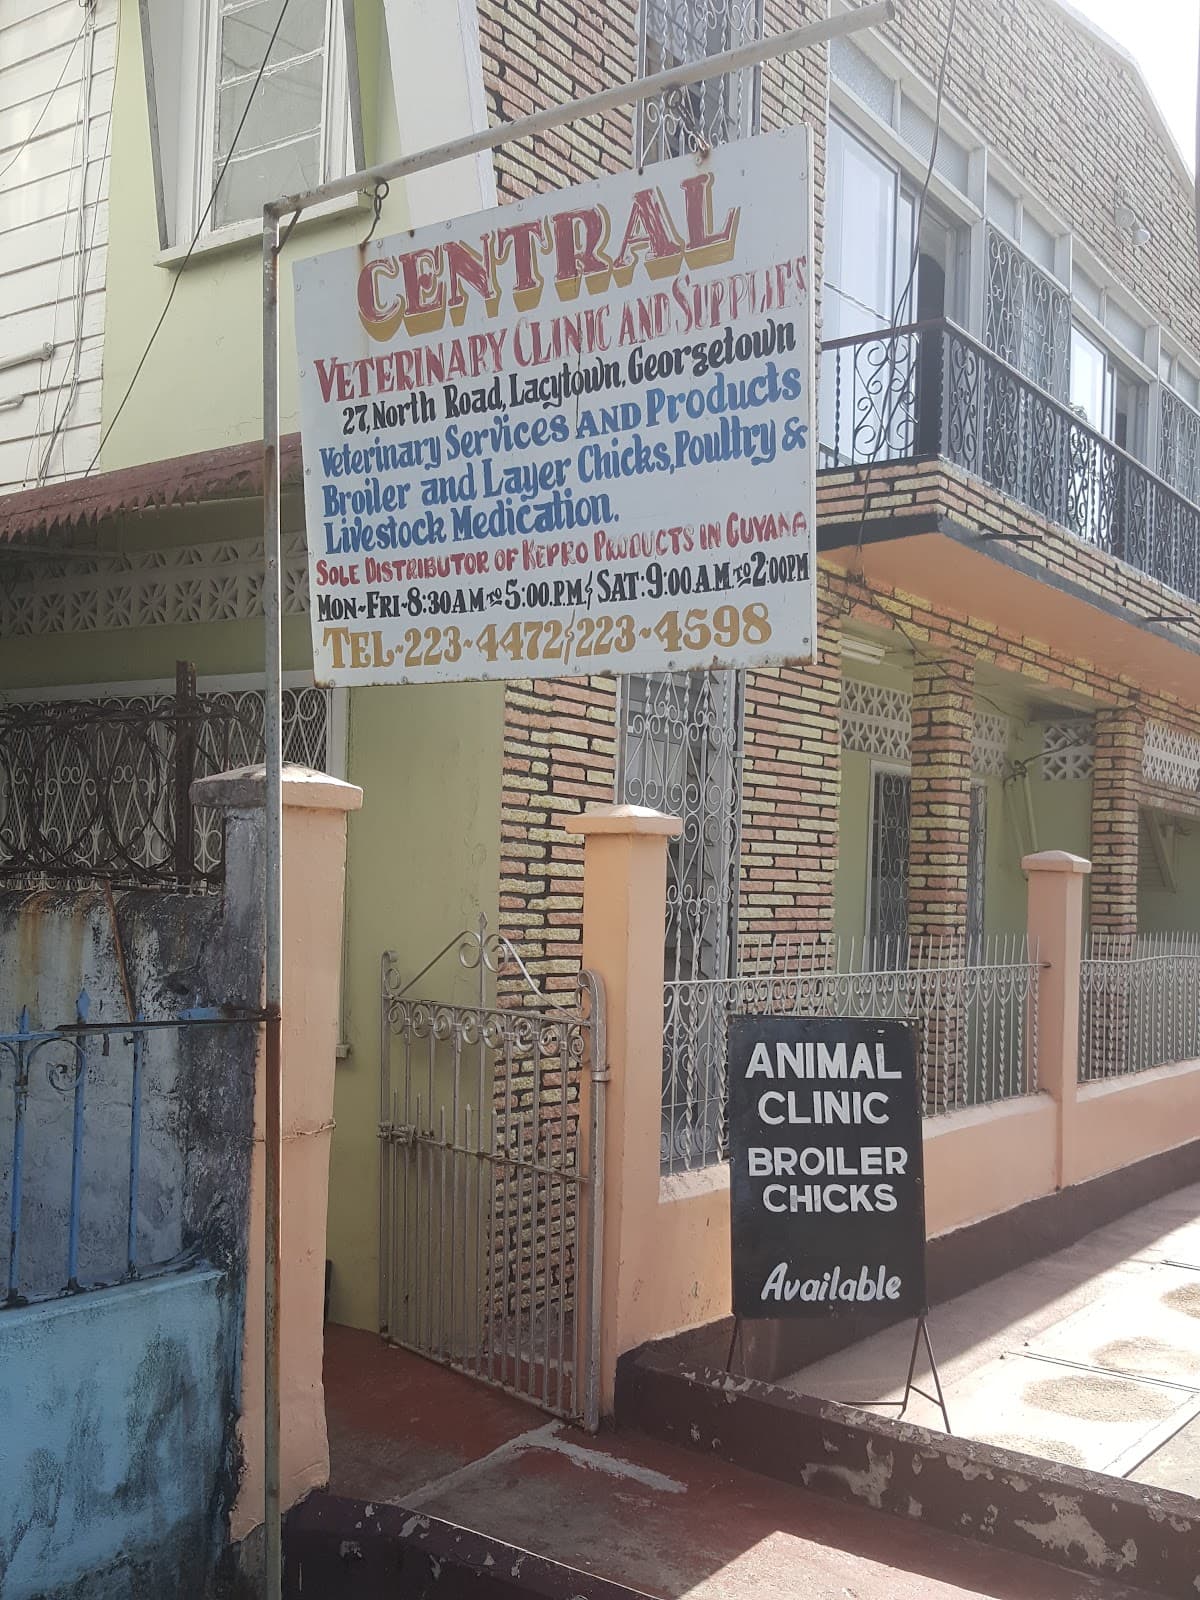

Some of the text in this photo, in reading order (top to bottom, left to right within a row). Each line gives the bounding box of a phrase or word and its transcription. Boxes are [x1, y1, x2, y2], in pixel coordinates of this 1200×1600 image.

[357, 172, 741, 342] CENTRAL
[313, 328, 508, 403] VETERINARY
[513, 304, 612, 367] CLINIC
[618, 293, 671, 347] AND
[443, 375, 506, 420] Road,
[628, 318, 797, 385] Georgetown
[319, 361, 802, 477] Veterinary Services AND Products
[322, 477, 411, 518] Broiler
[421, 462, 477, 507] and
[482, 456, 572, 501] Layer
[674, 415, 777, 469] Poultry
[781, 416, 808, 452] &
[316, 559, 360, 588] SOLE
[365, 550, 490, 584] DISTRIBUTOR
[494, 548, 518, 572] OF
[593, 524, 694, 562] PRODUCTS
[699, 521, 721, 550] IN
[726, 511, 807, 548] GUYANA
[324, 486, 619, 555] Livestock Medication.
[745, 1042, 902, 1080] ANIMAL
[758, 1090, 890, 1125] CLINIC
[747, 1146, 908, 1177] BROILER
[762, 1183, 898, 1213] CHICKS
[760, 1261, 902, 1302] Available
